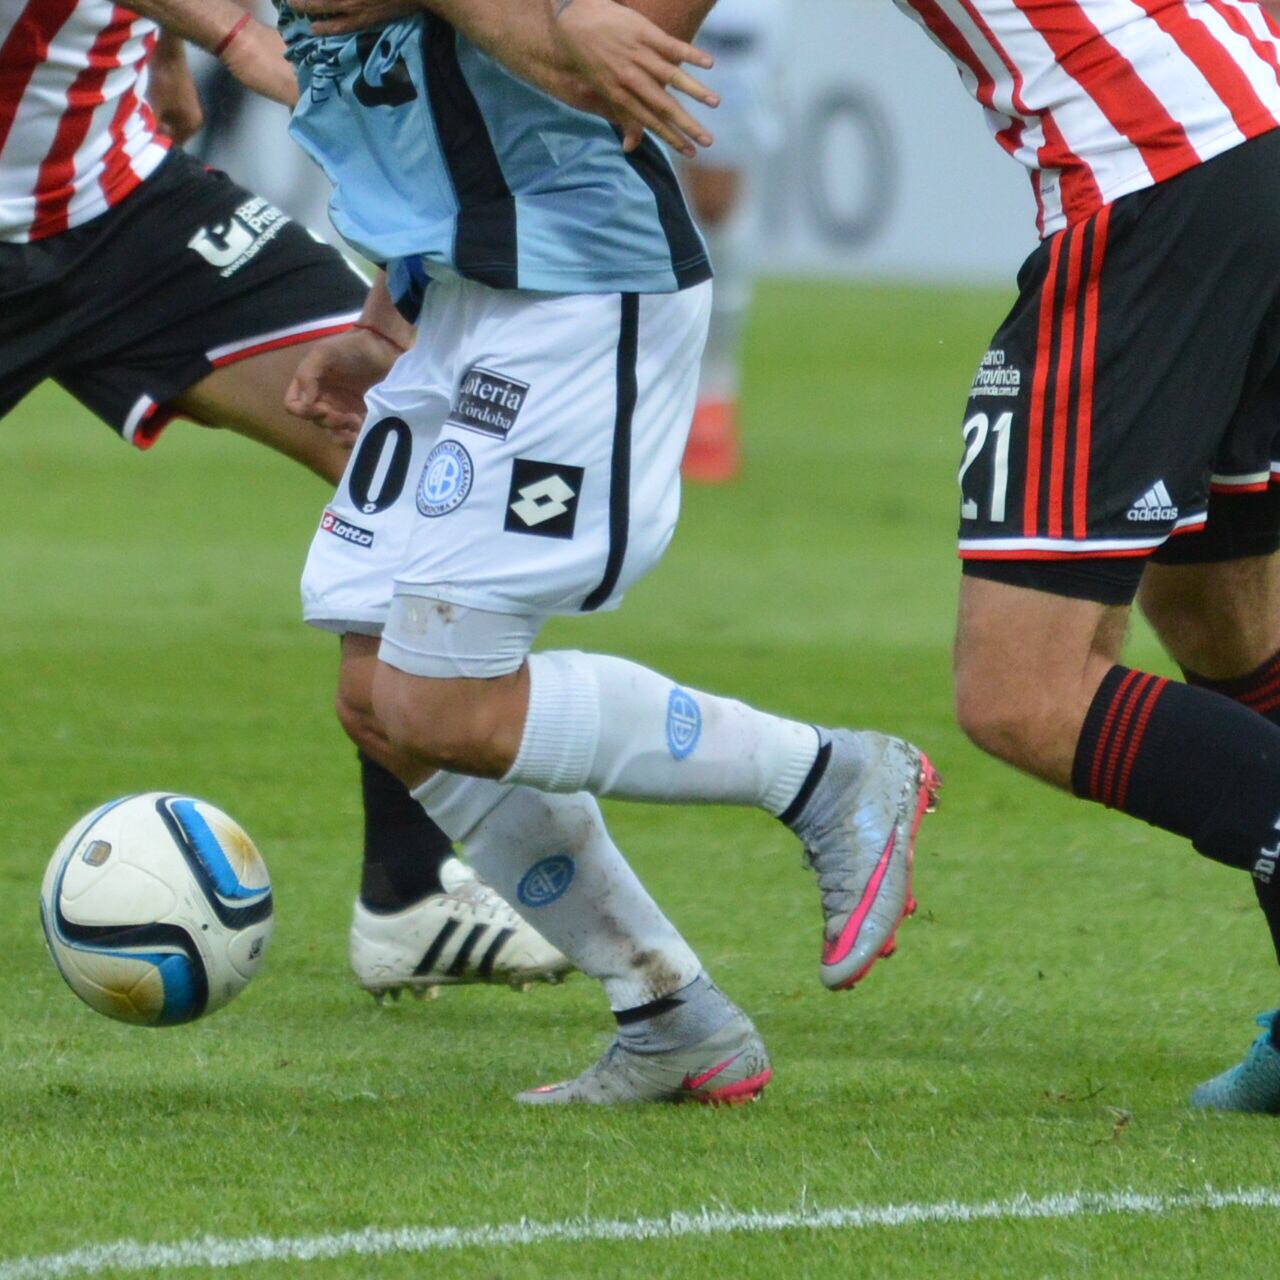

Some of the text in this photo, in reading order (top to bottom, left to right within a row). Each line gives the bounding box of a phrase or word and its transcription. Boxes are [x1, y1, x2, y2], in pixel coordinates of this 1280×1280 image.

[975, 365, 1021, 386] Provincia
[957, 411, 1014, 523] 21
[1127, 506, 1178, 522] adidas
